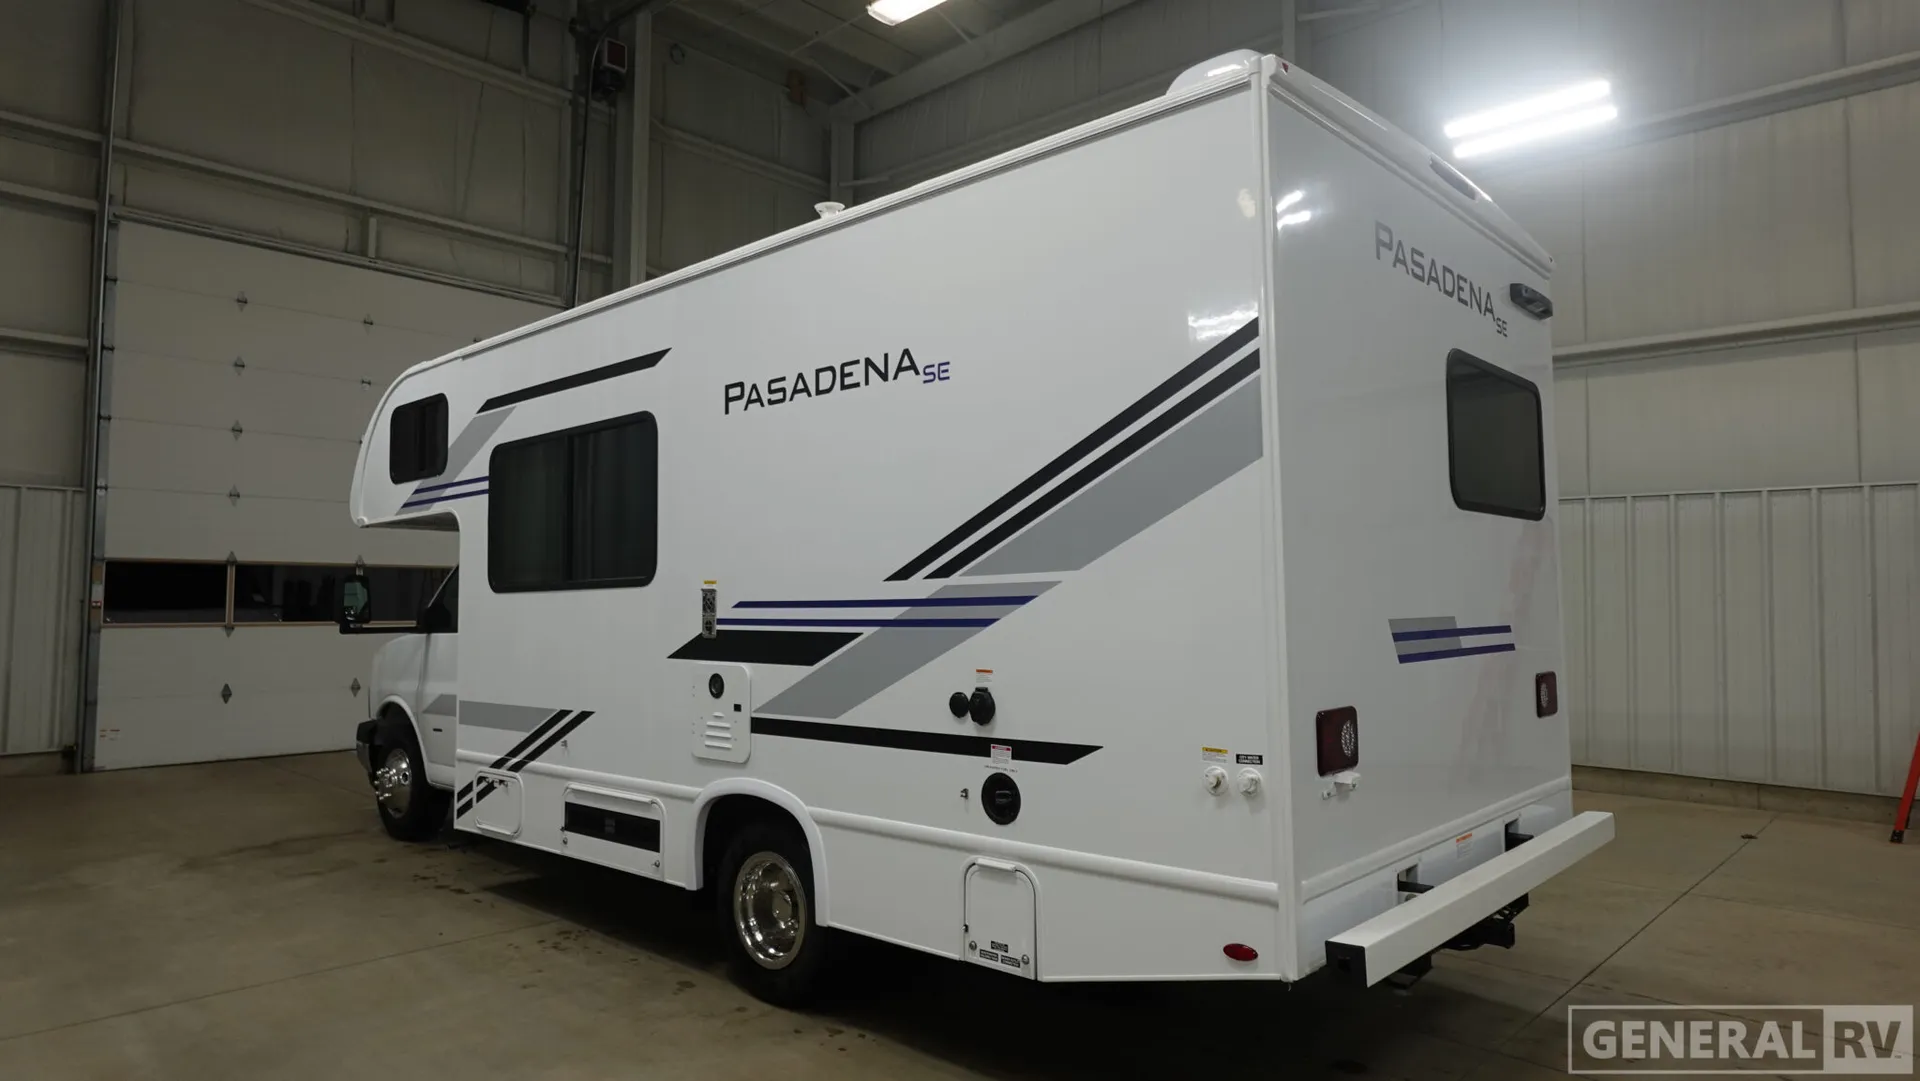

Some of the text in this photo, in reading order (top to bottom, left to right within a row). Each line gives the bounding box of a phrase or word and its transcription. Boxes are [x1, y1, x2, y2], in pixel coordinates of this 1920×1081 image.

[1375, 220, 1508, 338] PASADENA SE
[724, 348, 950, 415] PASADENA SE
